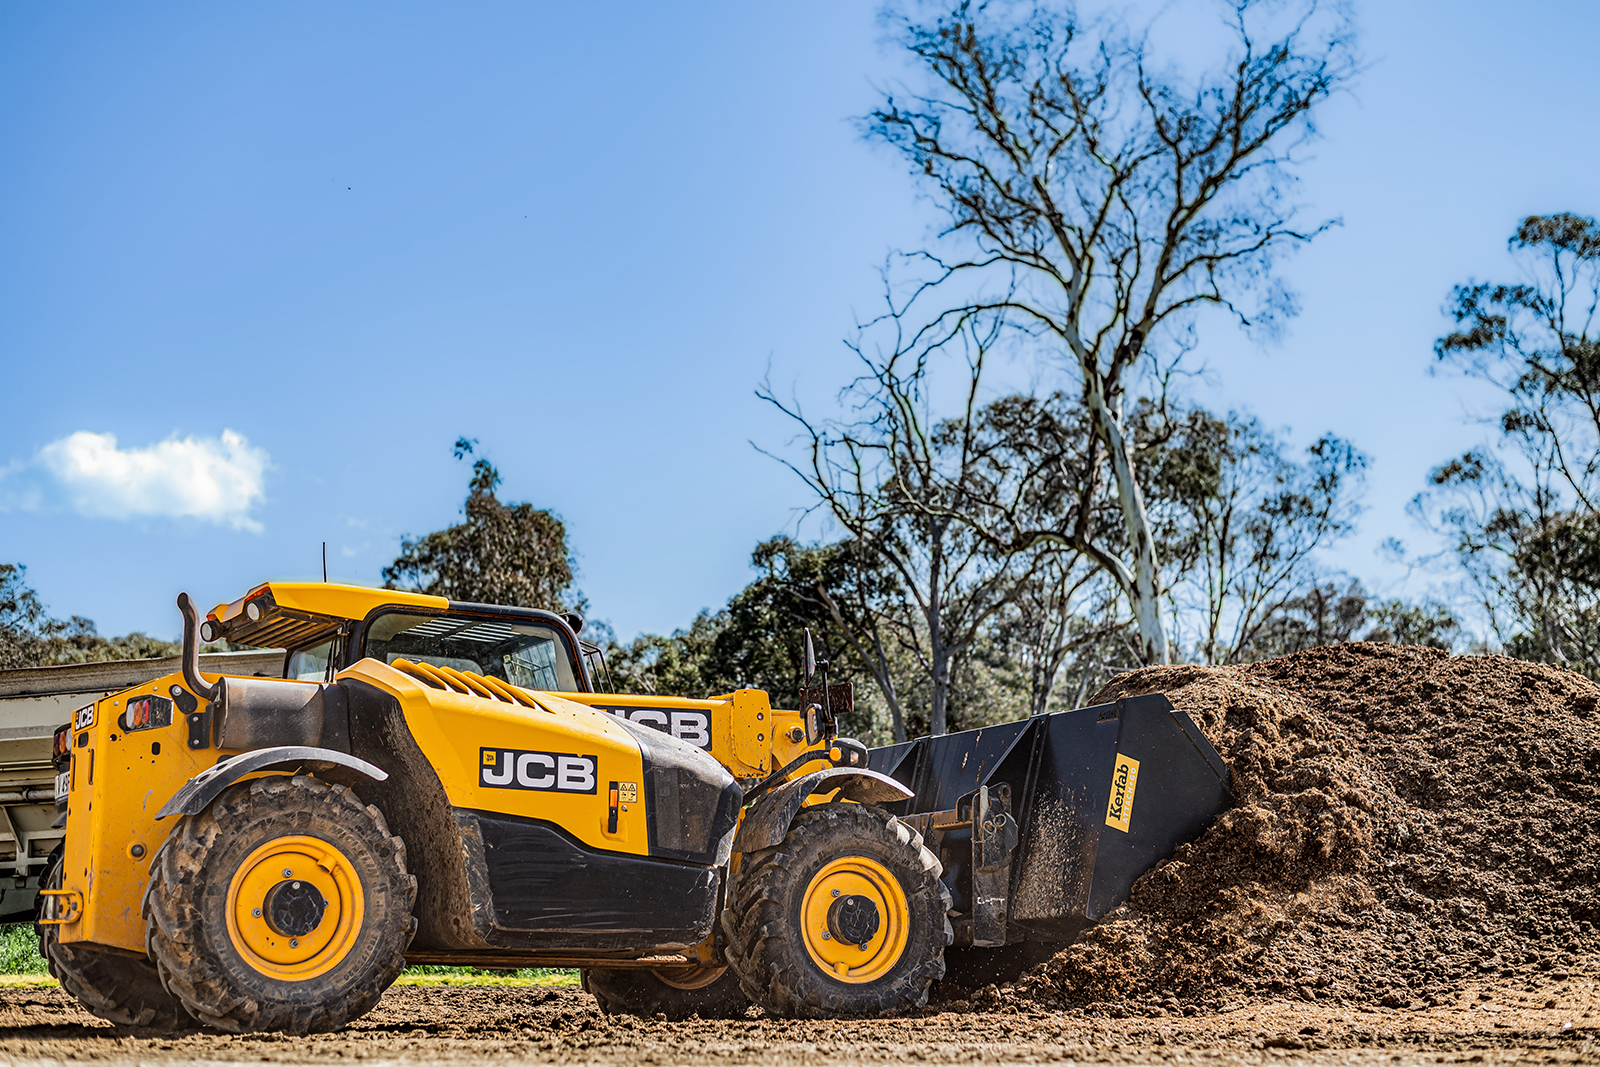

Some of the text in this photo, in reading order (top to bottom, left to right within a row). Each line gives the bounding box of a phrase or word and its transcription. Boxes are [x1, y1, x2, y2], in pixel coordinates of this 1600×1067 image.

[75, 705, 94, 729] JCB
[482, 752, 595, 791] JCB
[1109, 764, 1129, 821] Kerfab
